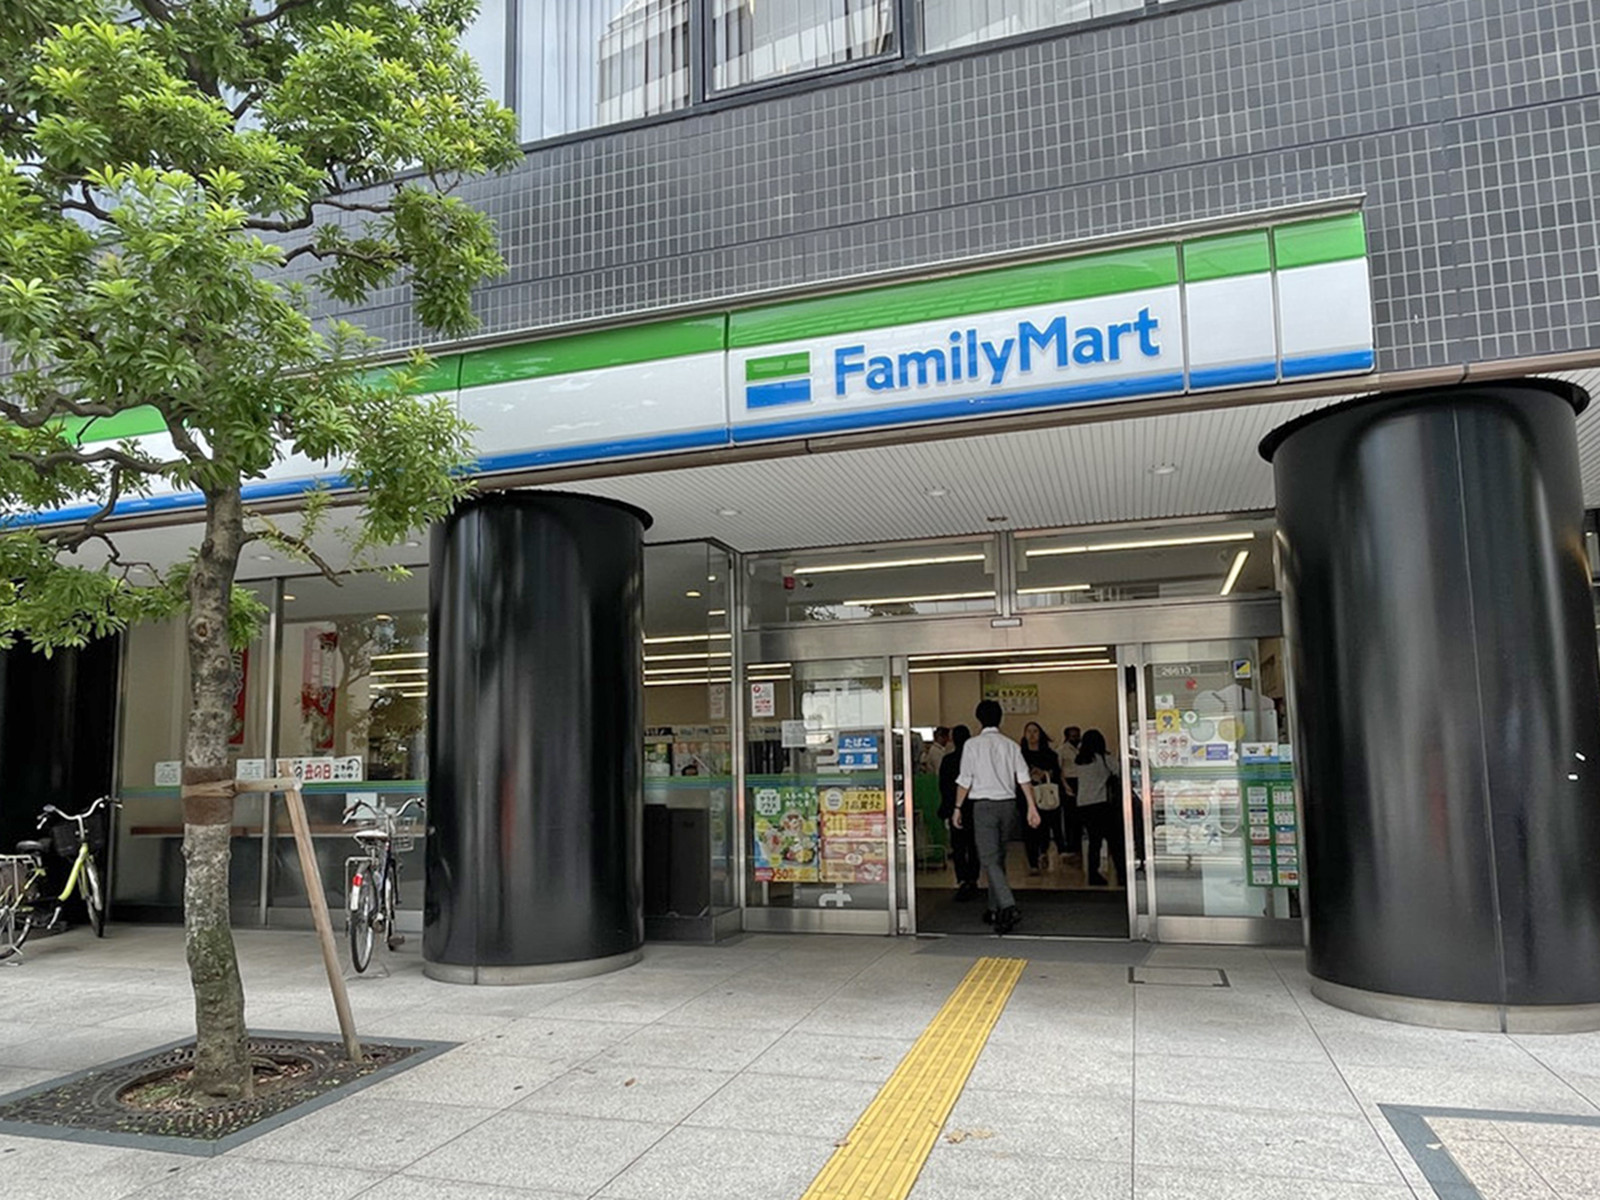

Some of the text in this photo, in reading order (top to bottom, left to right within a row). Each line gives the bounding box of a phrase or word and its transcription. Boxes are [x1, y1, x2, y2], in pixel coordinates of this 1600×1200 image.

[834, 307, 1160, 396] FamilyMart
[844, 737, 872, 748] たばこ
